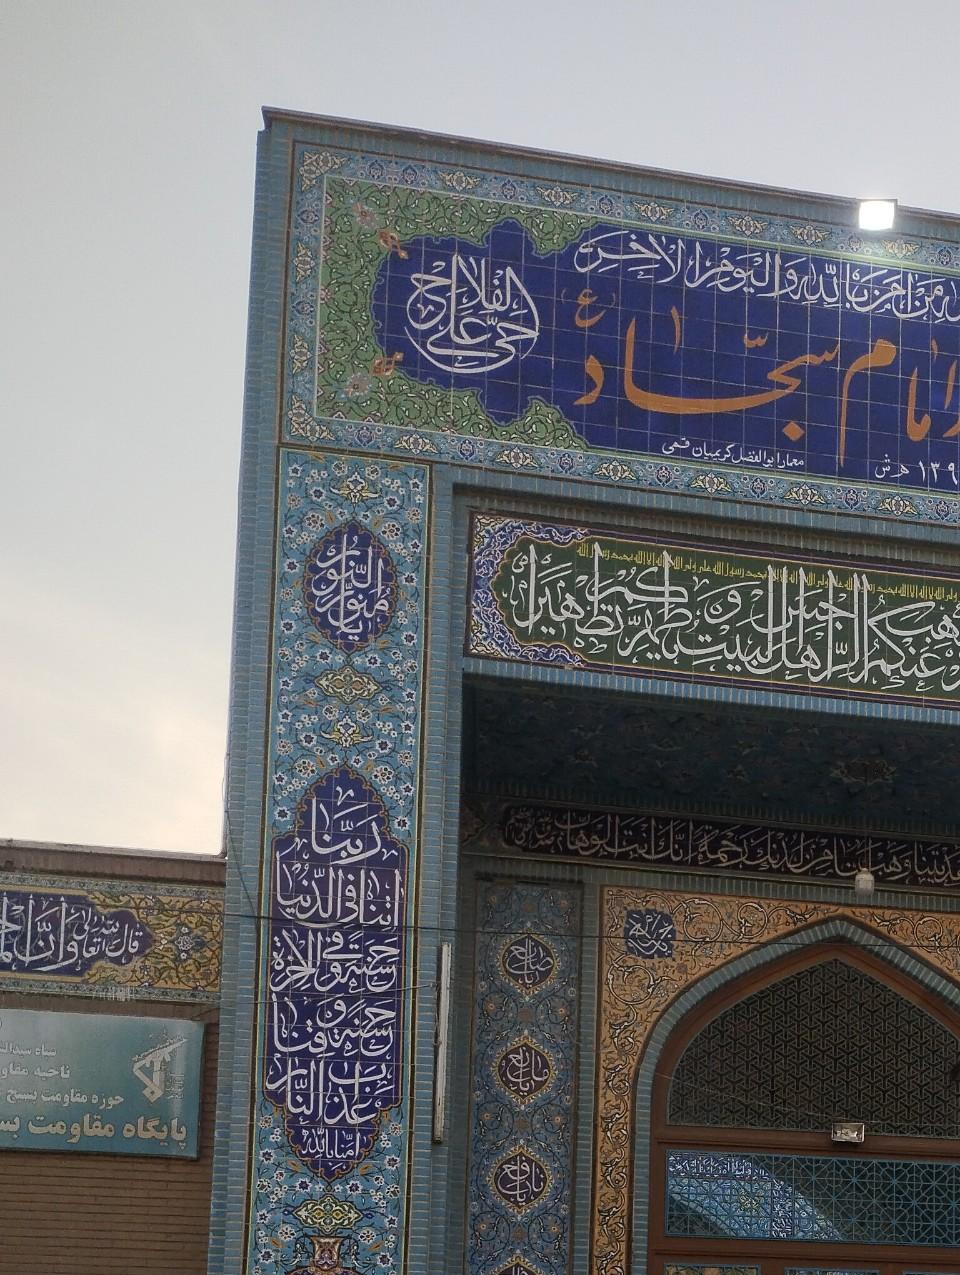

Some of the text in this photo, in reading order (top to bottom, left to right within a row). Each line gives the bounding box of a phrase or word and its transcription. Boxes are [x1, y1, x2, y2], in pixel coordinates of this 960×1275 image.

[312, 797, 382, 866] ربنا
[42, 1088, 88, 1107] مقاومت
[28, 1113, 116, 1144] مقاومت
[122, 1115, 187, 1150] پایگاه
